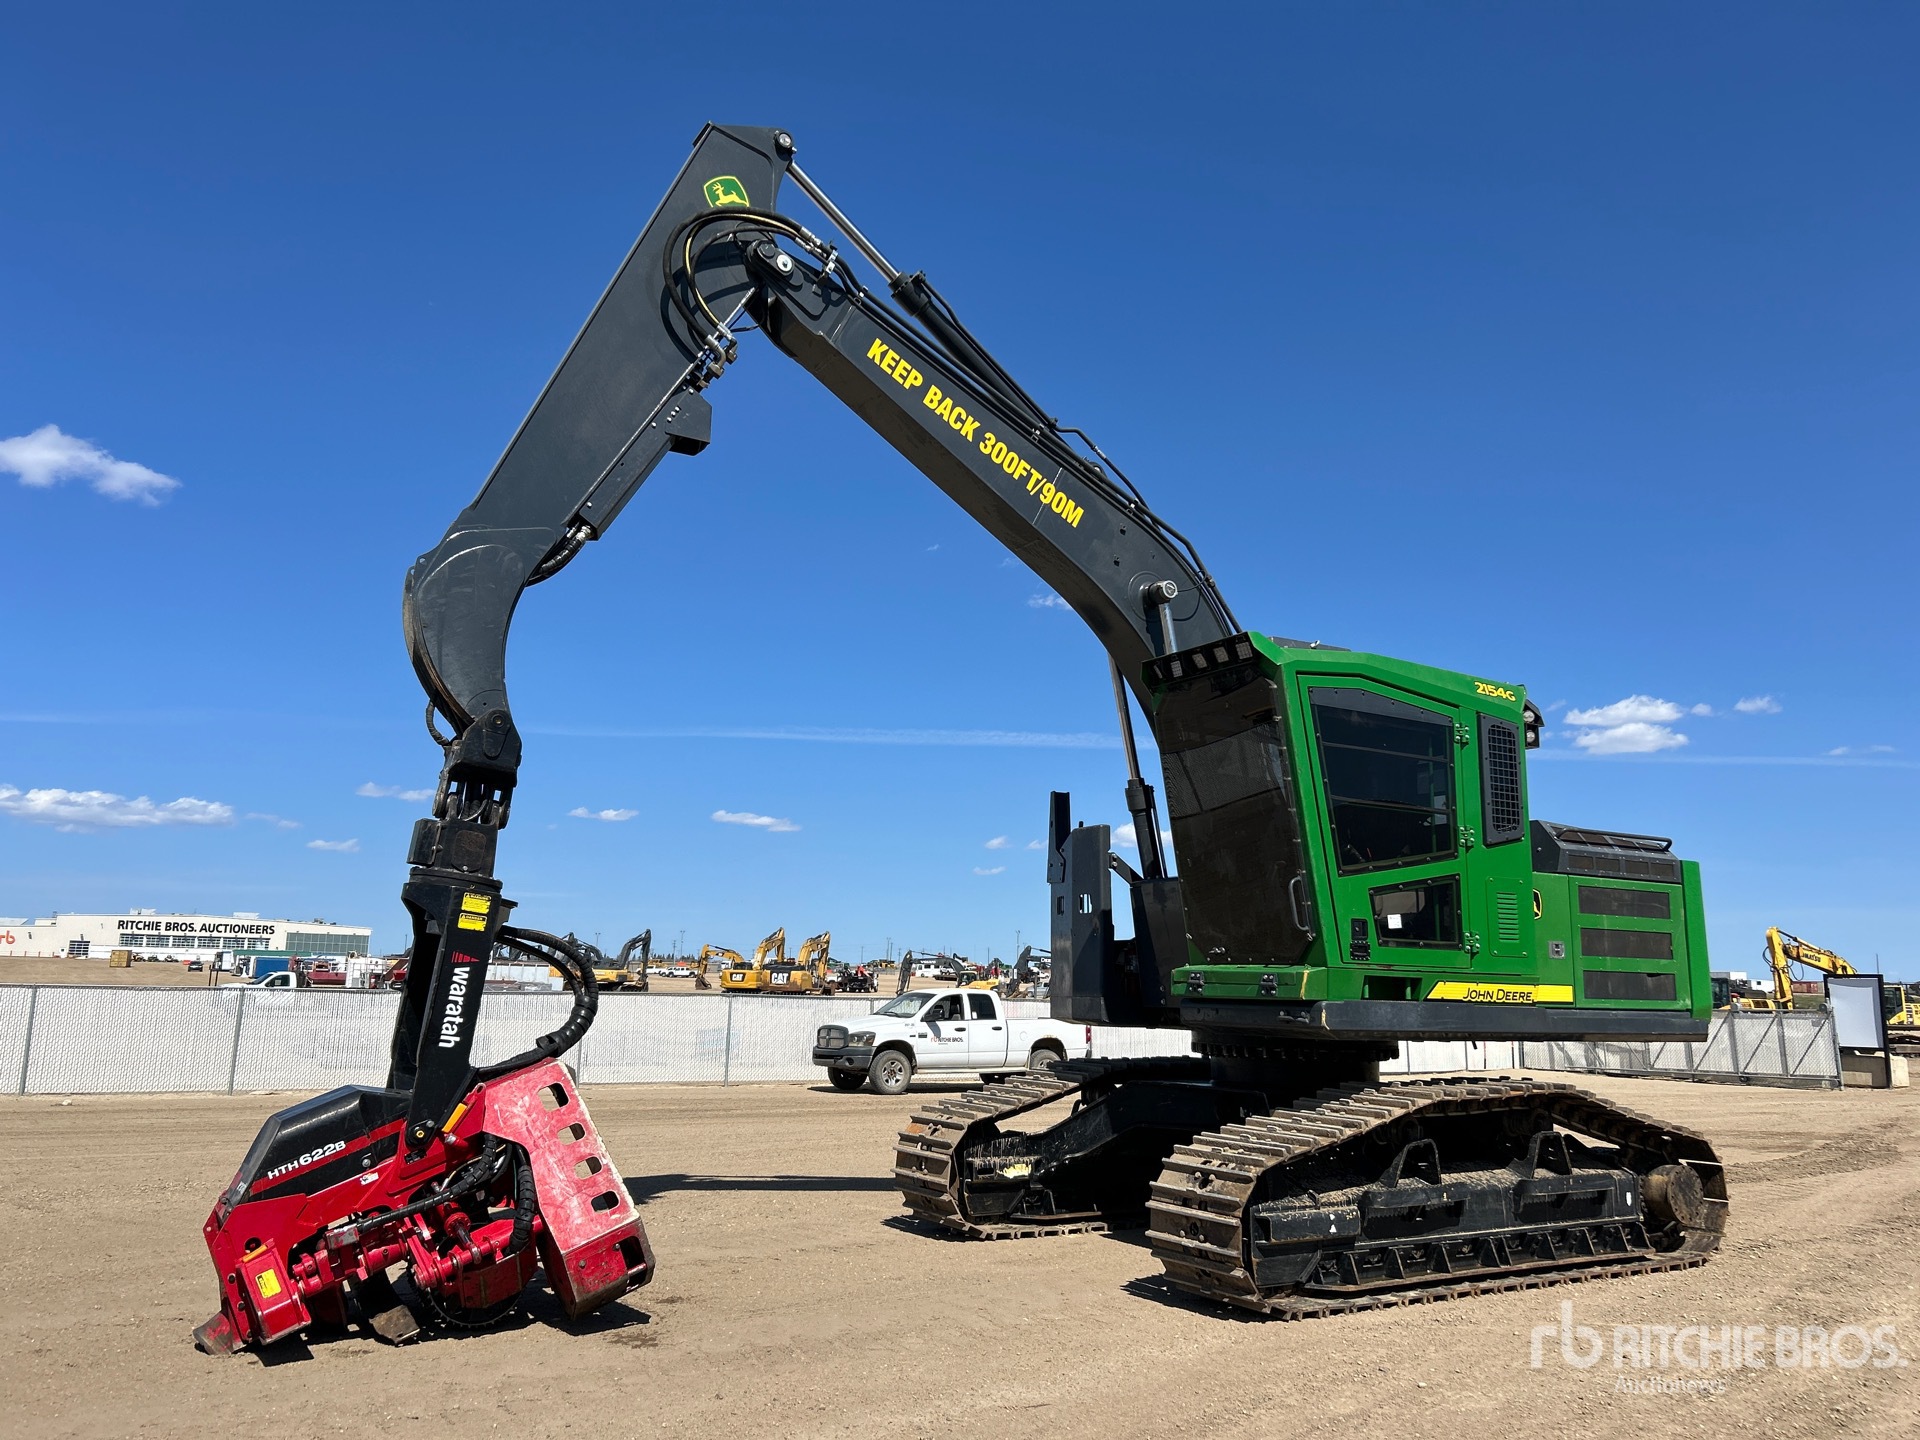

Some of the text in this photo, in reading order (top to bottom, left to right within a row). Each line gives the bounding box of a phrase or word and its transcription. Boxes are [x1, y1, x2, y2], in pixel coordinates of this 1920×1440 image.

[866, 337, 1085, 528] KEEP BACK 300FT/90M
[1474, 681, 1516, 702] 2154G
[117, 919, 276, 935] RITCHIE BROS. AUCTIONEERS
[731, 973, 744, 982] CAT
[771, 972, 789, 985] CAT
[1463, 987, 1533, 1002] JOHN DEERE
[438, 966, 471, 1048] waratah
